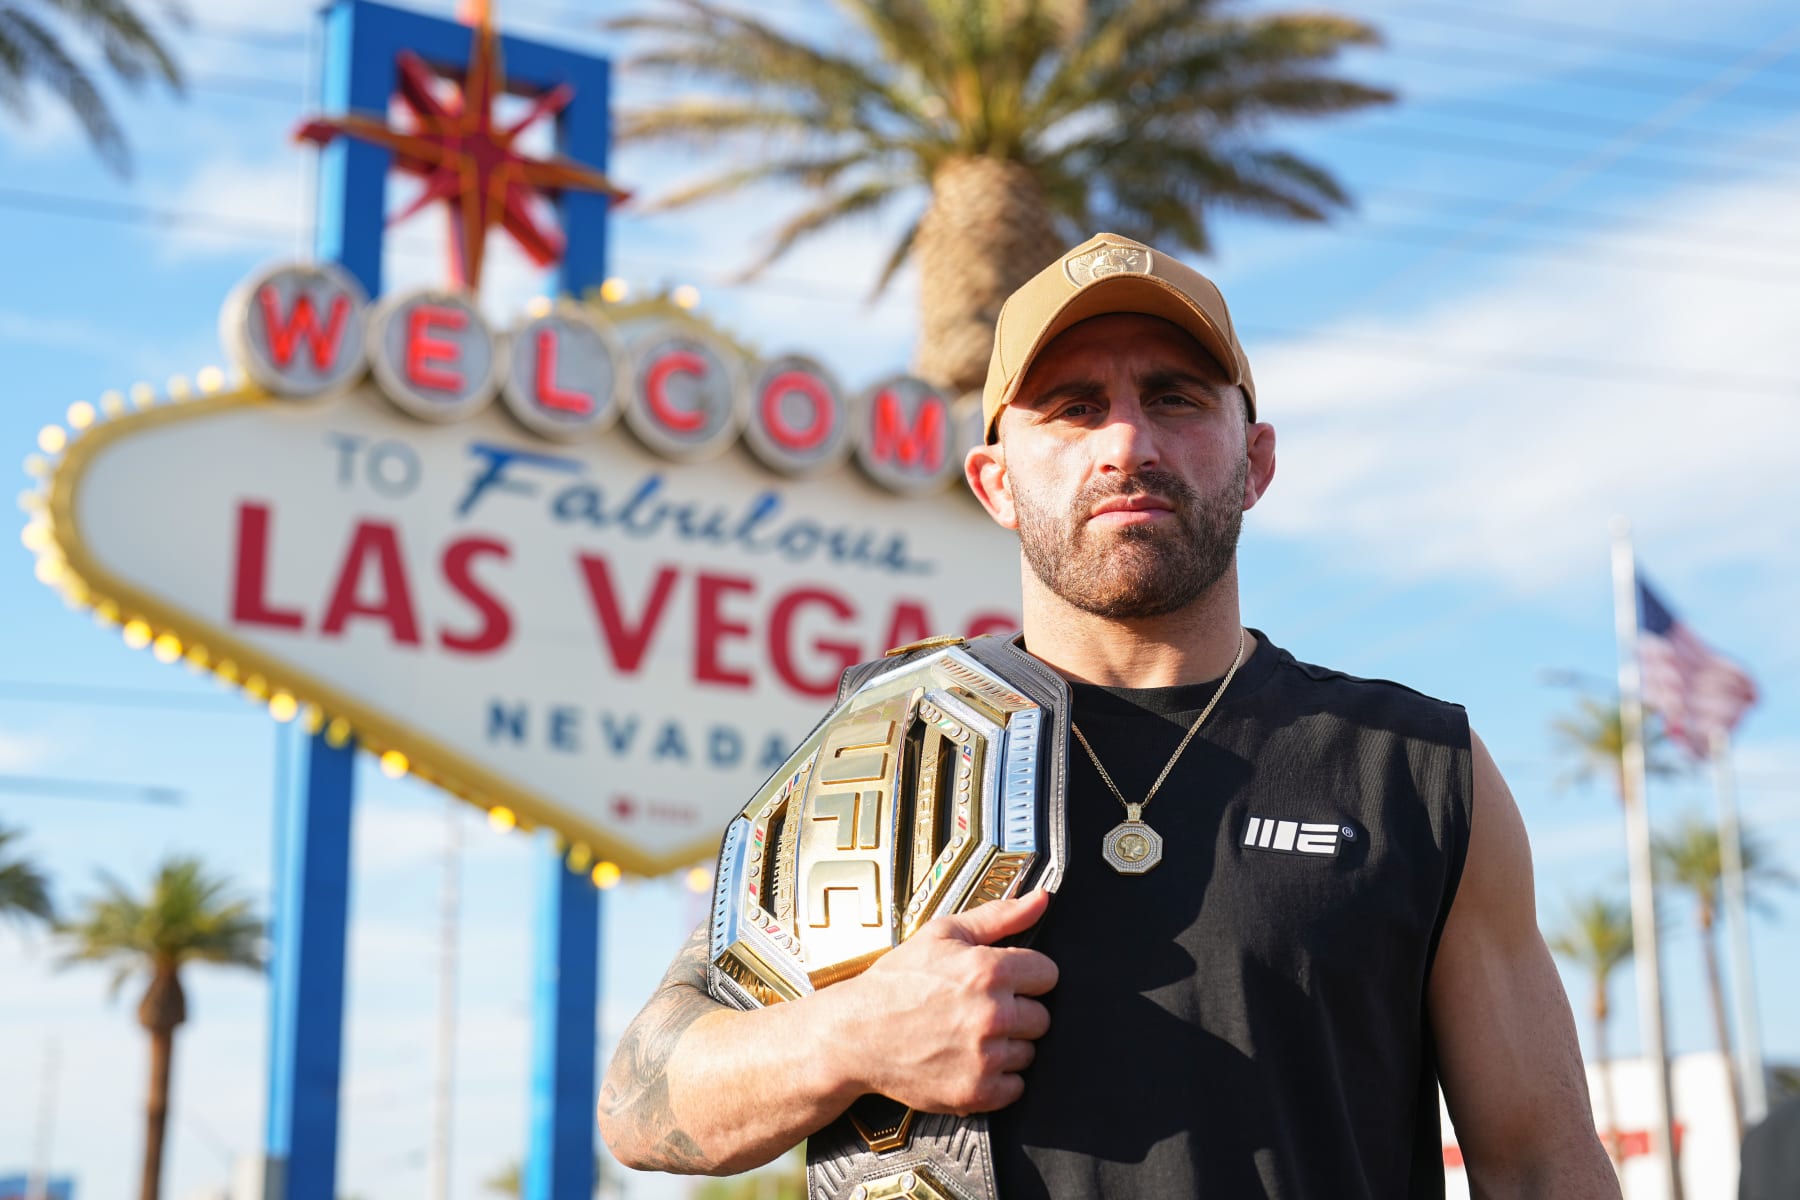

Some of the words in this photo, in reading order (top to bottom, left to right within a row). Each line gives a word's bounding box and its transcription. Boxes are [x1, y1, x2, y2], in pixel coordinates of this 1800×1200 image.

[258, 284, 946, 473] WELCOM
[326, 431, 422, 499] TO
[456, 443, 936, 574] Fabulous
[232, 500, 516, 657] LAS
[574, 547, 1020, 699] VEG
[487, 700, 790, 772] NEVADA
[917, 753, 937, 859] WORLD
[807, 719, 896, 928] UFC
